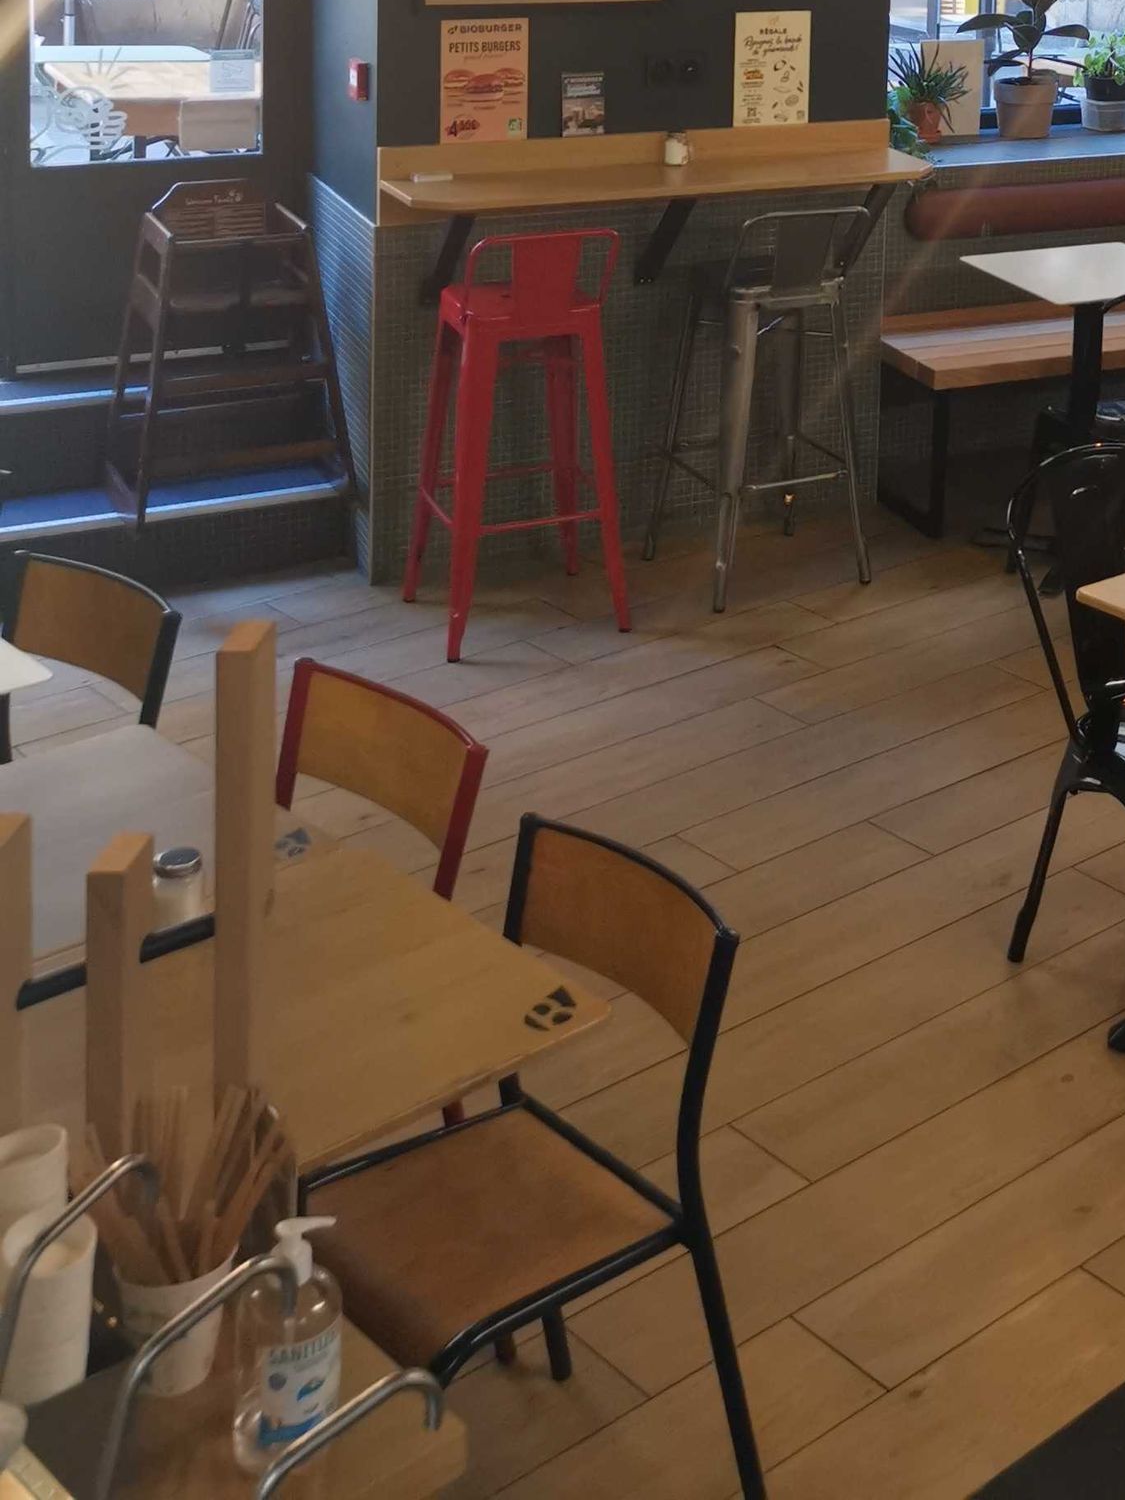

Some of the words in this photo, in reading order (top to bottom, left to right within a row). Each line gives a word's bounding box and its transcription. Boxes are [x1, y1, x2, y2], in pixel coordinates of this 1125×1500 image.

[460, 23, 523, 34] BIOBURGER
[448, 41, 480, 54] PETITS
[481, 40, 521, 53] BURGERS
